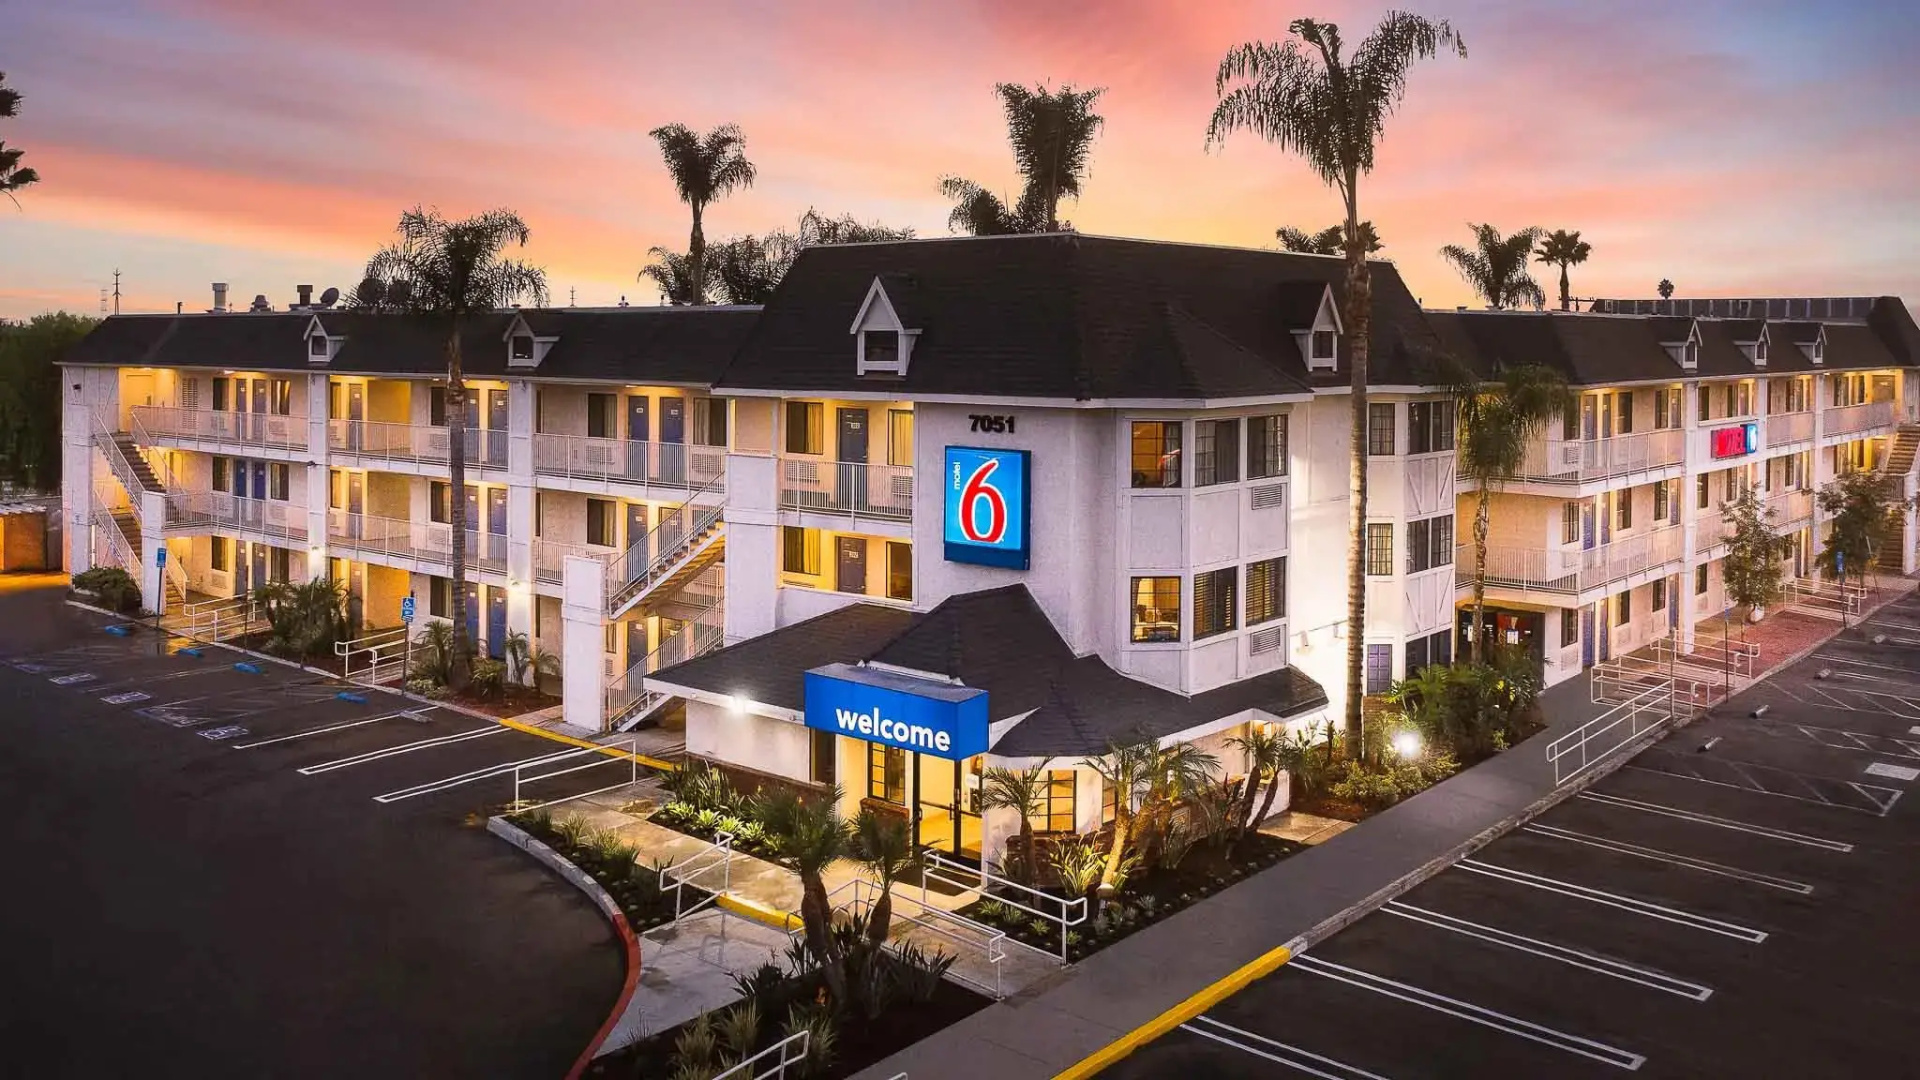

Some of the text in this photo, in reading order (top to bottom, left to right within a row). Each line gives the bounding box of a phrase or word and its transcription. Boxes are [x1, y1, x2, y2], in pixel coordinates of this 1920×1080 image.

[969, 415, 1015, 433] 7051
[953, 458, 1007, 543] motel 6
[836, 707, 951, 751] welcome
